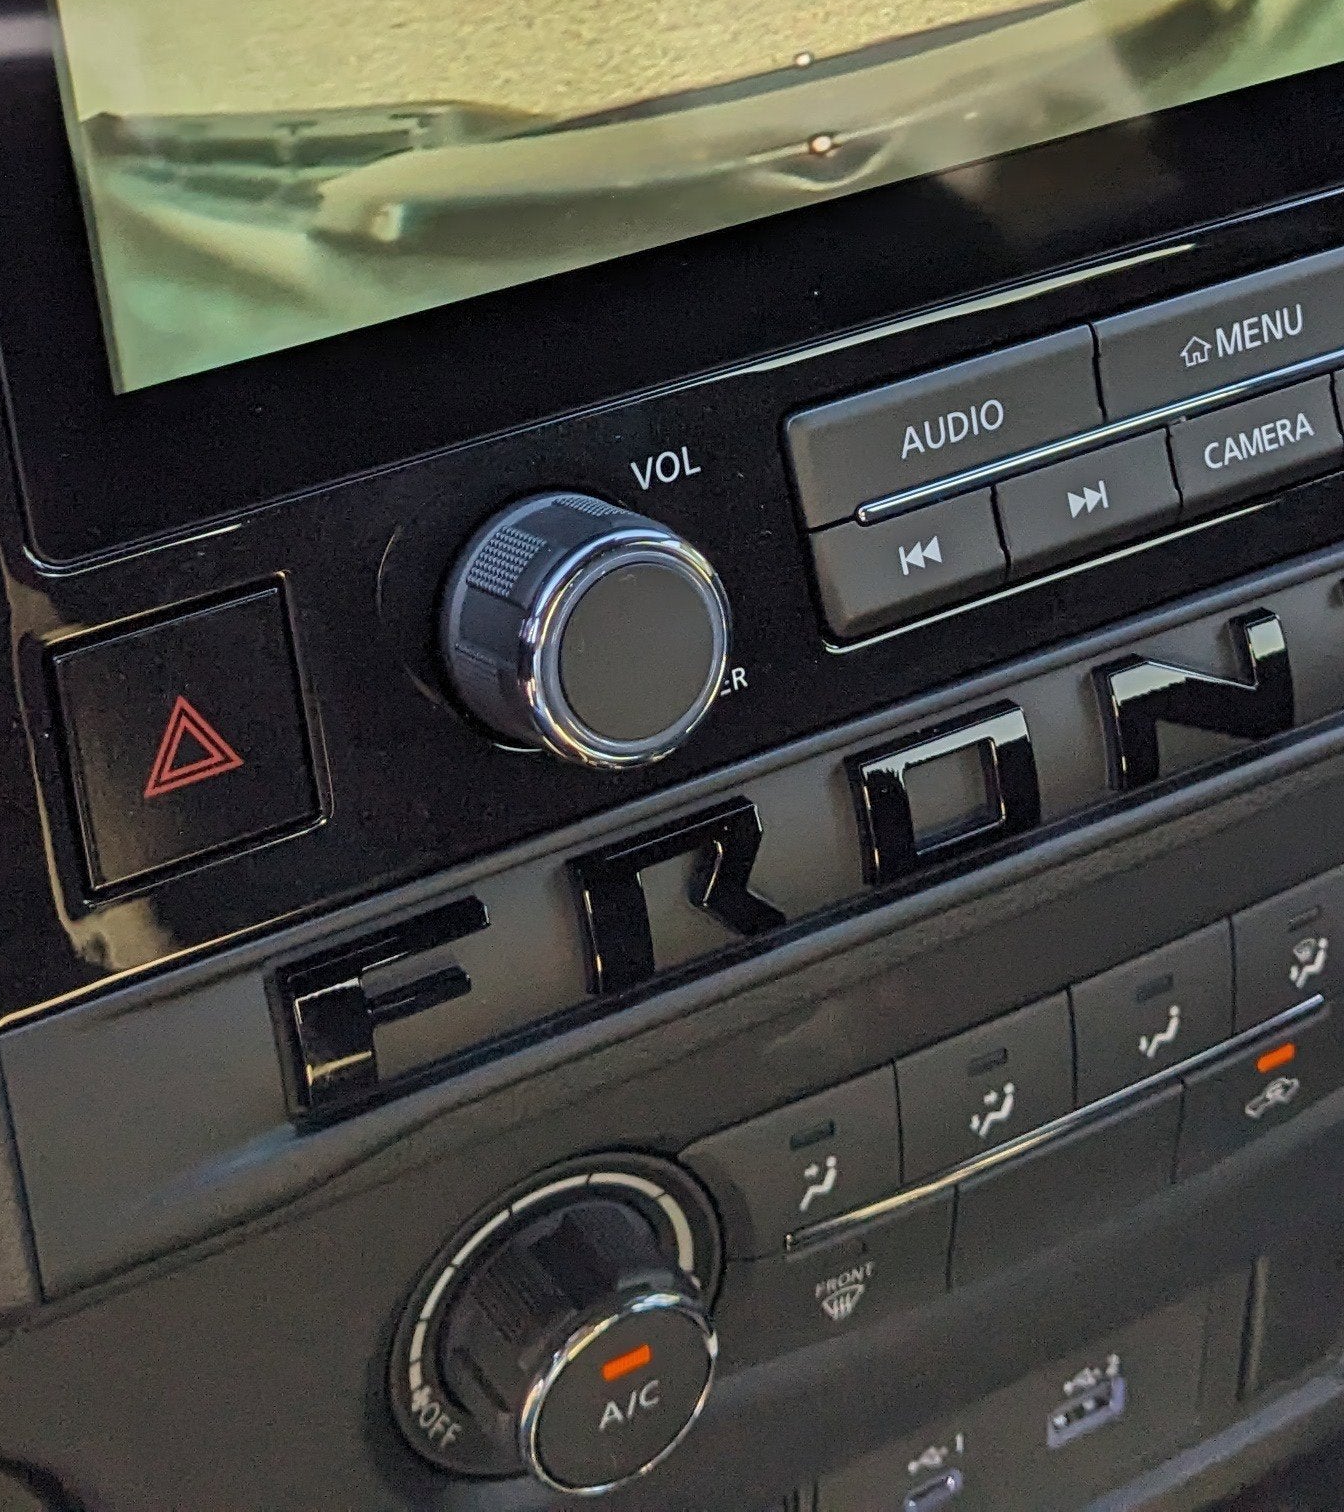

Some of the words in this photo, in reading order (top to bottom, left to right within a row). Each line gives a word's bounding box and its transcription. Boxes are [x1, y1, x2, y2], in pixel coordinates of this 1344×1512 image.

[1216, 304, 1305, 357] MENU
[901, 399, 1005, 460] AUDIO
[1204, 412, 1315, 470] CAMERA
[631, 446, 701, 489] VOL
[815, 1260, 876, 1299] FRONT
[419, 1402, 462, 1448] OFF
[599, 1380, 659, 1430] A/C
